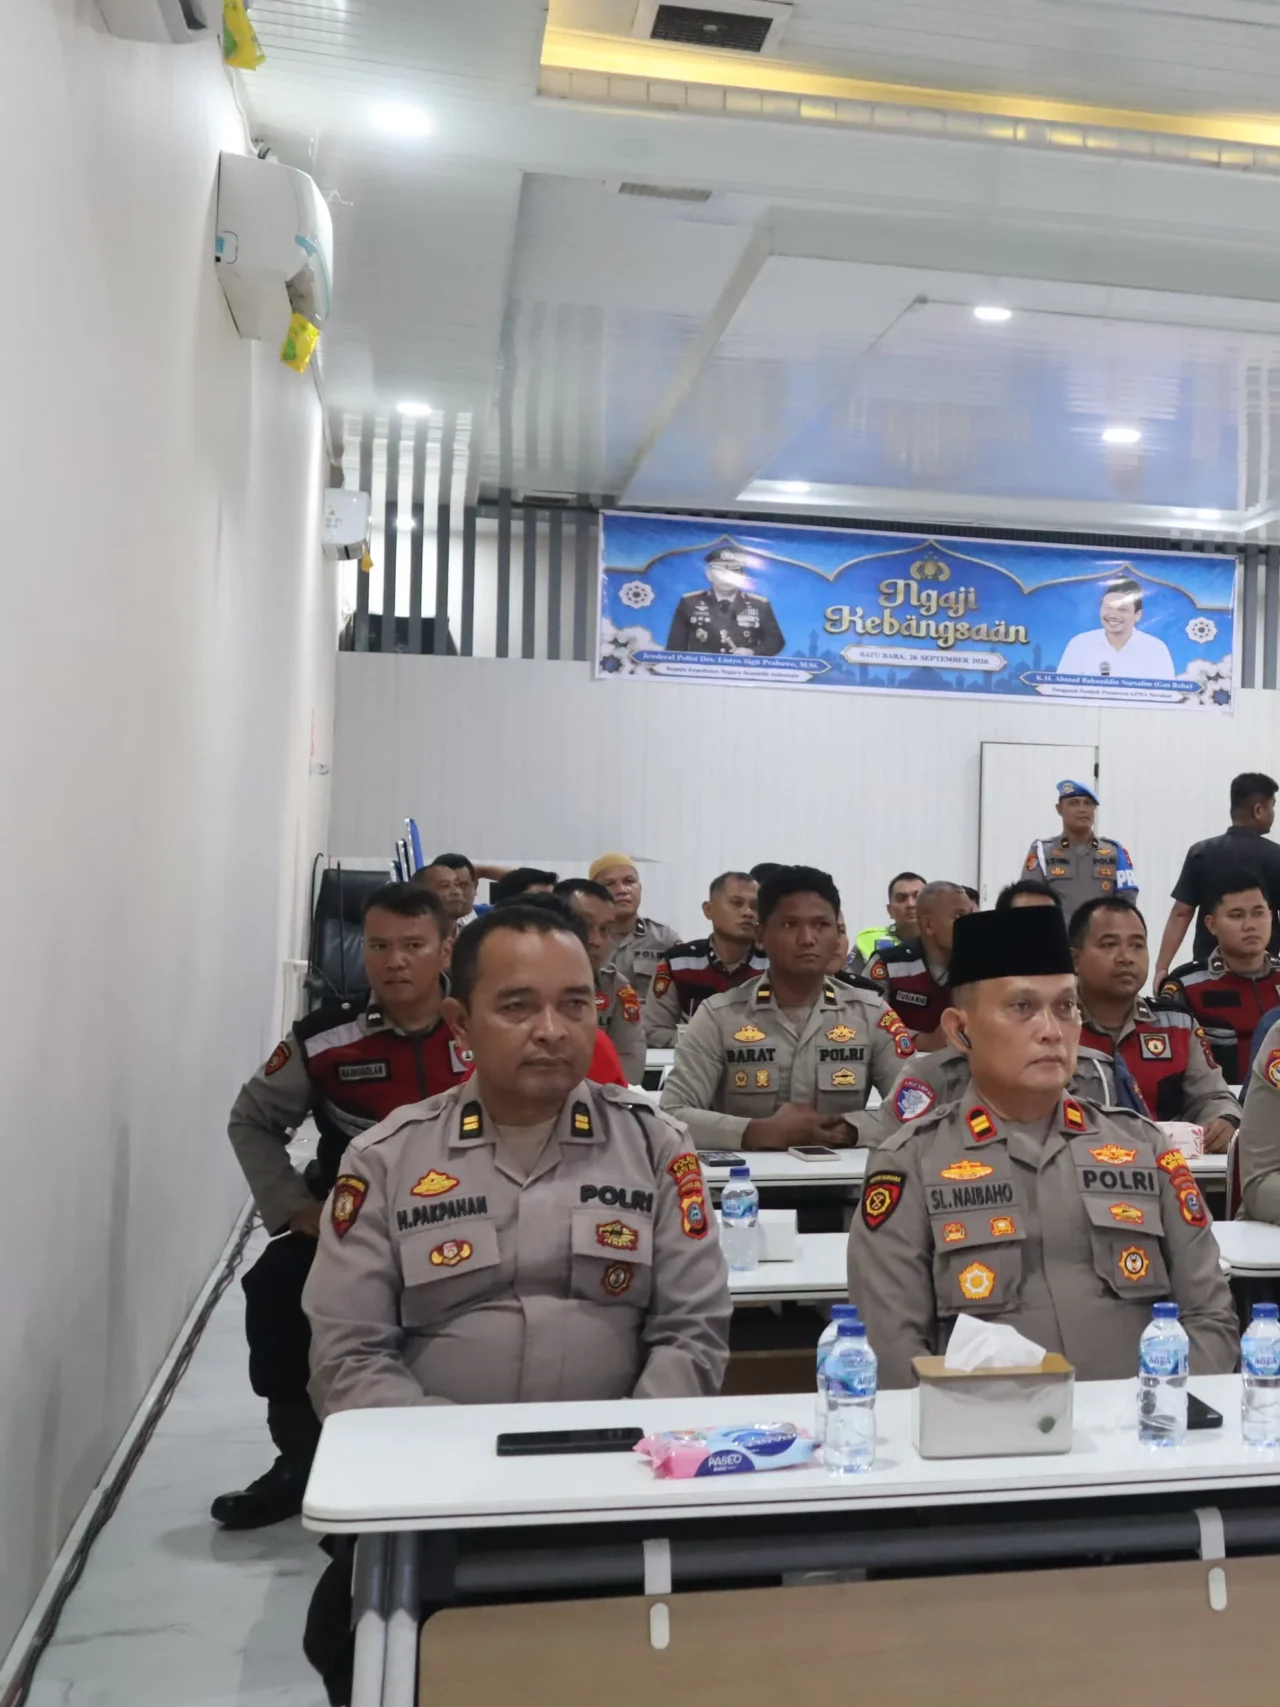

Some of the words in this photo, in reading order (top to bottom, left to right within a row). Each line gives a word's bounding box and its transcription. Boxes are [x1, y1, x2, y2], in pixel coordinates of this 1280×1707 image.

[878, 578, 980, 618] Ngaji
[859, 651, 880, 659] BATU
[920, 655, 969, 664] SEPTEMBER
[727, 1047, 776, 1063] BARAT
[819, 1047, 864, 1062] POLRI
[1082, 1170, 1155, 1192] POLRI
[580, 1184, 654, 1213] POLRI
[397, 1195, 488, 1231] H.PAKPAHAN
[1149, 1357, 1172, 1366] AQUA
[1254, 1357, 1278, 1366] AQUA
[708, 1454, 742, 1468] PASEO
